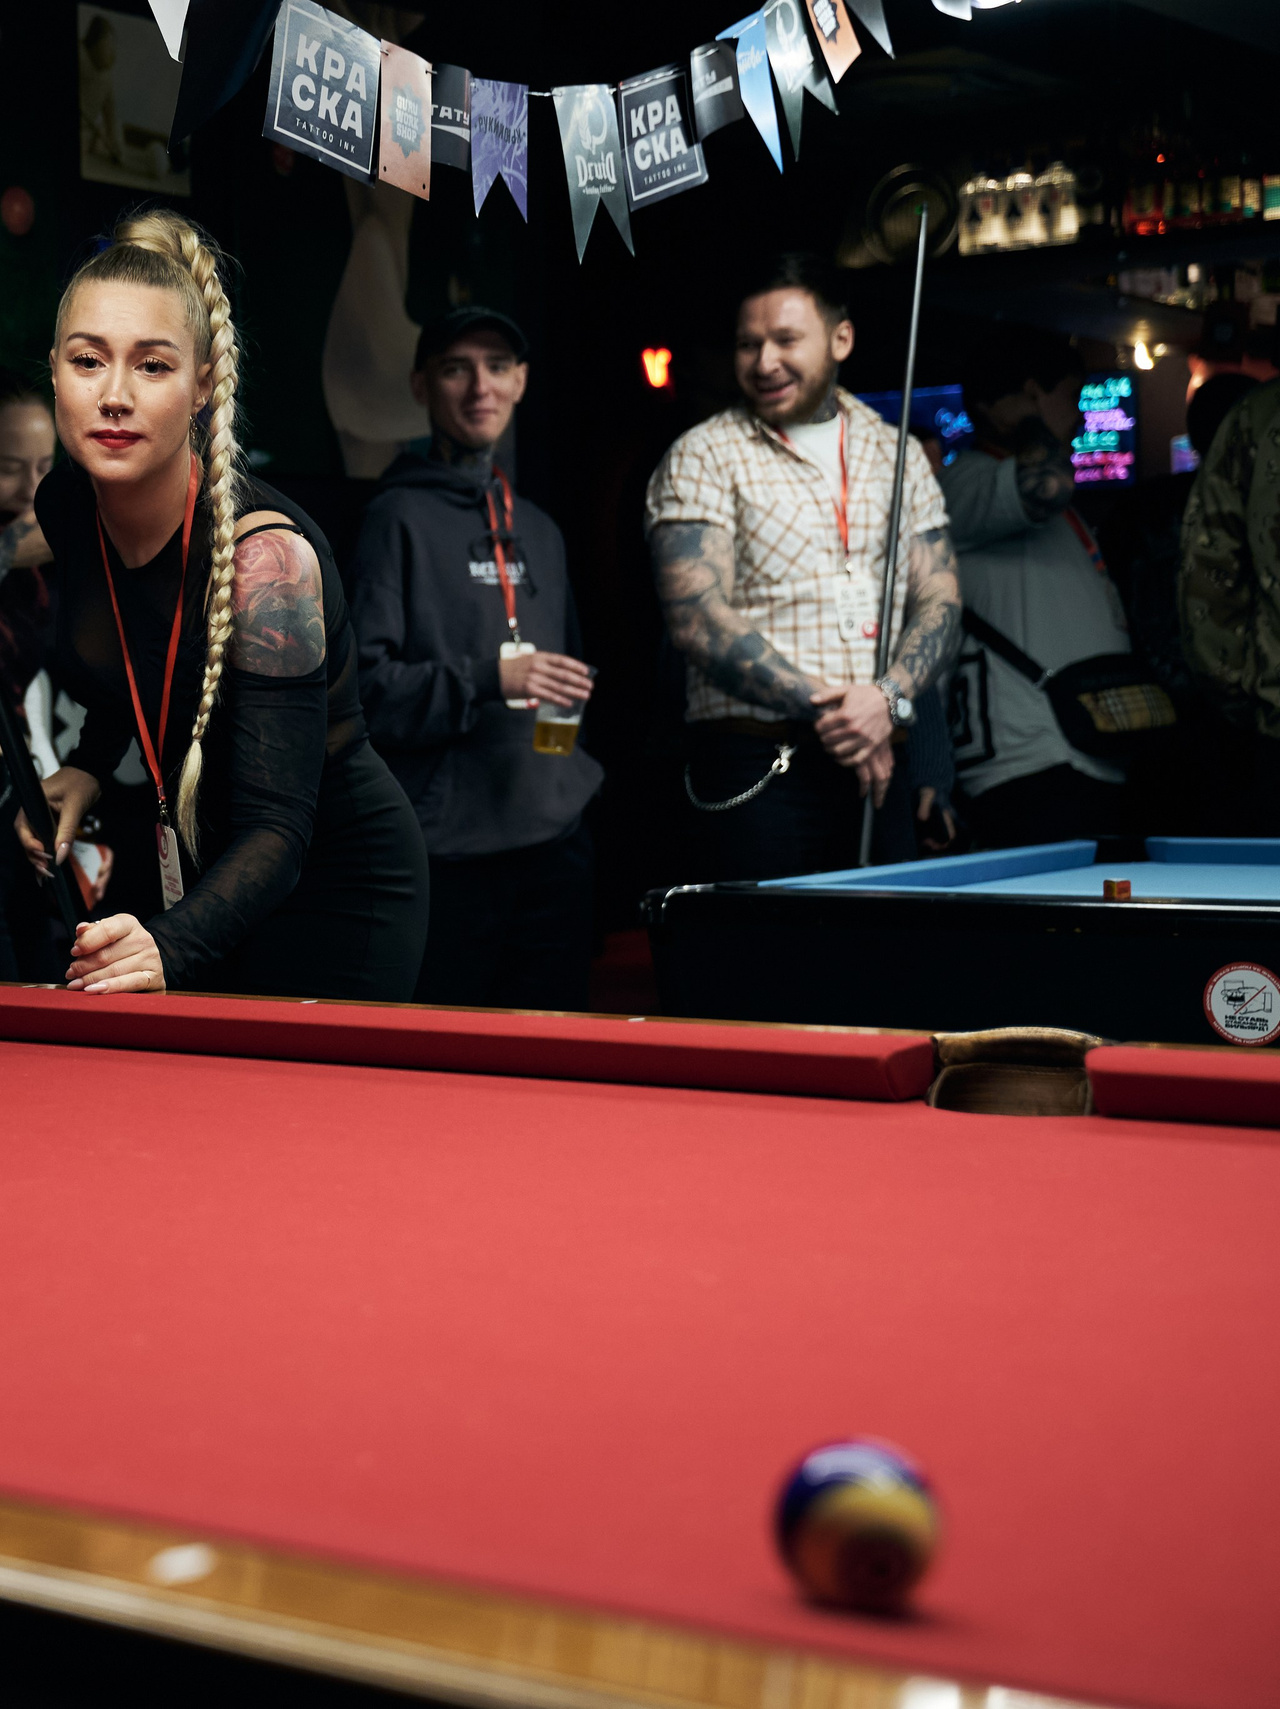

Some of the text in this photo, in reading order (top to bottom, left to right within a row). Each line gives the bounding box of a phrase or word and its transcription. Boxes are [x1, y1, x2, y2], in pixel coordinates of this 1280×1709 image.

[296, 33, 366, 101] КРА
[292, 74, 363, 139] СКА
[395, 108, 419, 131] WORK
[396, 95, 418, 116] GURU
[630, 94, 682, 139] КРА
[296, 117, 356, 154] TATTOO INK
[396, 123, 418, 143] SHOP
[634, 126, 688, 171] СКА
[644, 167, 670, 185] TATTOO
